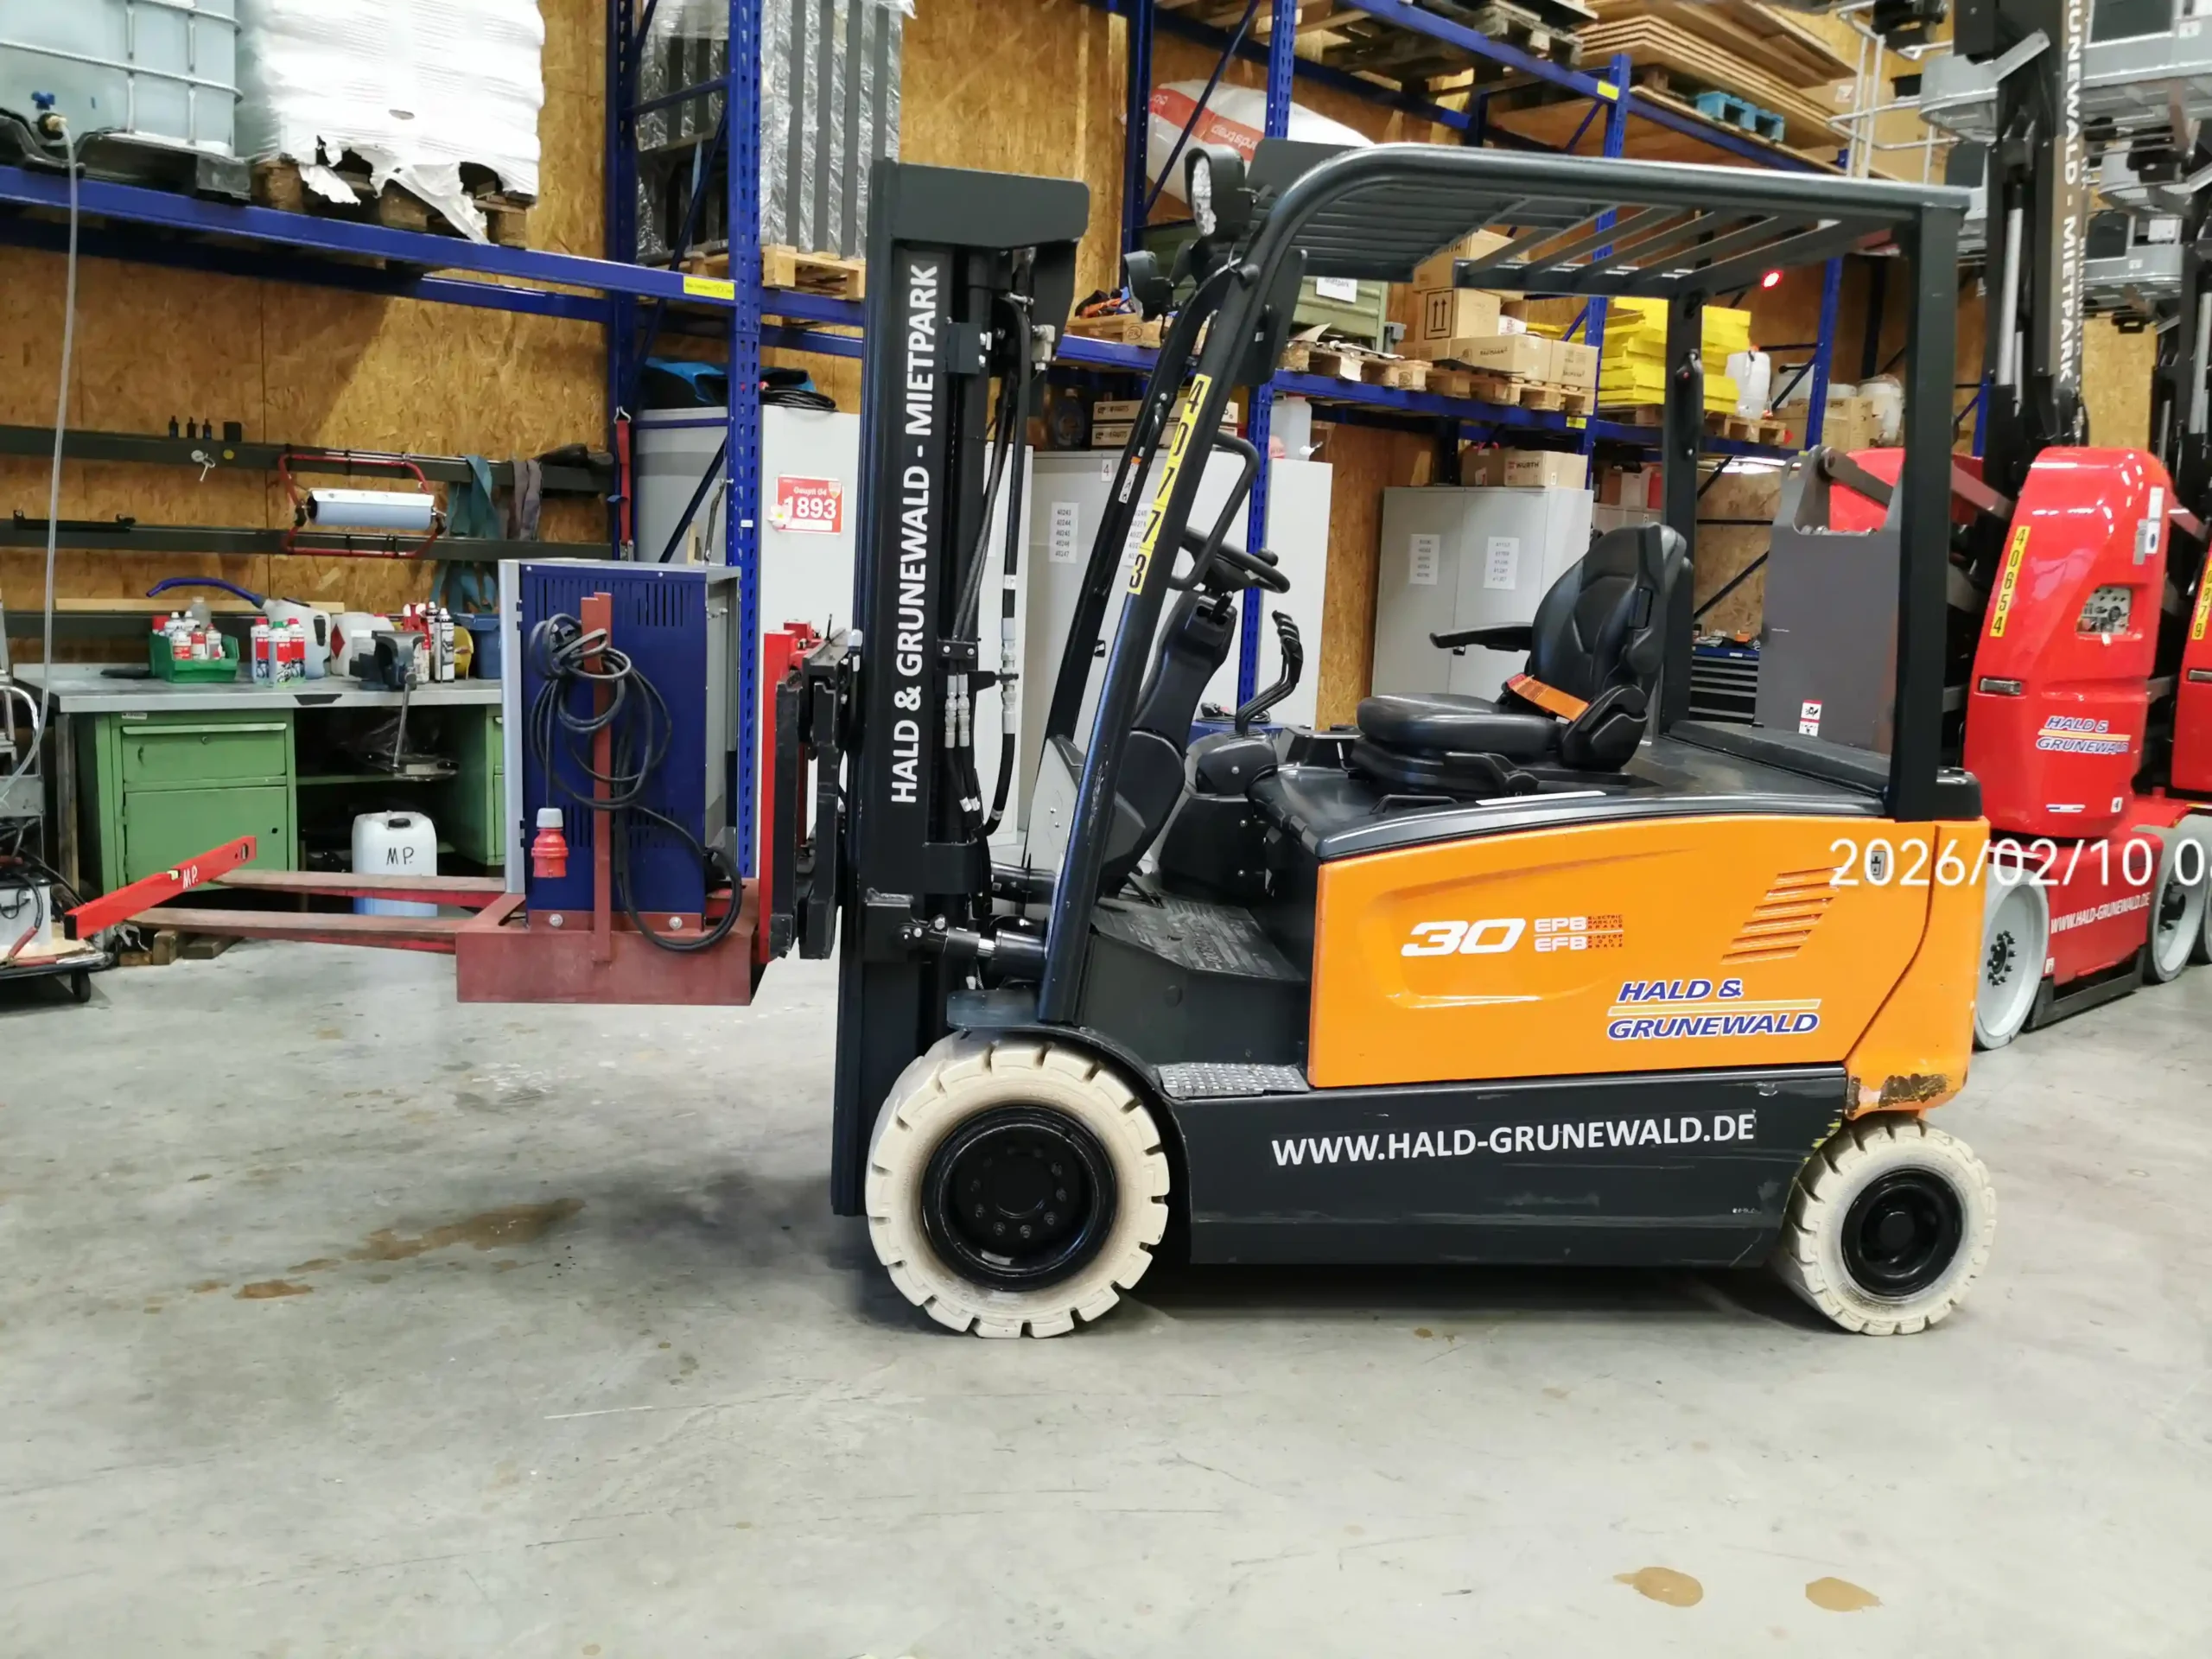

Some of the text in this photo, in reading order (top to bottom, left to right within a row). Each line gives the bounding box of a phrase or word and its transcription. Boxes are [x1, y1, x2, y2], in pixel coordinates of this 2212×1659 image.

[2060, 215, 2077, 383] MIETPARK
[906, 264, 938, 436] MIETPARK
[1103, 464, 1109, 477] 4
[784, 495, 836, 520] 1893
[896, 466, 930, 677] GRUNEWALD
[894, 685, 922, 711] &
[2044, 715, 2095, 732] HALD
[891, 720, 918, 803] HALD
[1401, 918, 1526, 957] 30
[1535, 917, 1587, 932] EPB
[1535, 936, 1587, 952] EFB
[1617, 978, 1744, 1002] HALD &
[1606, 1013, 1820, 1039] GRUNEWALD
[1272, 1114, 1756, 1166] WWW.HALD-GRUNEWALD.DE
